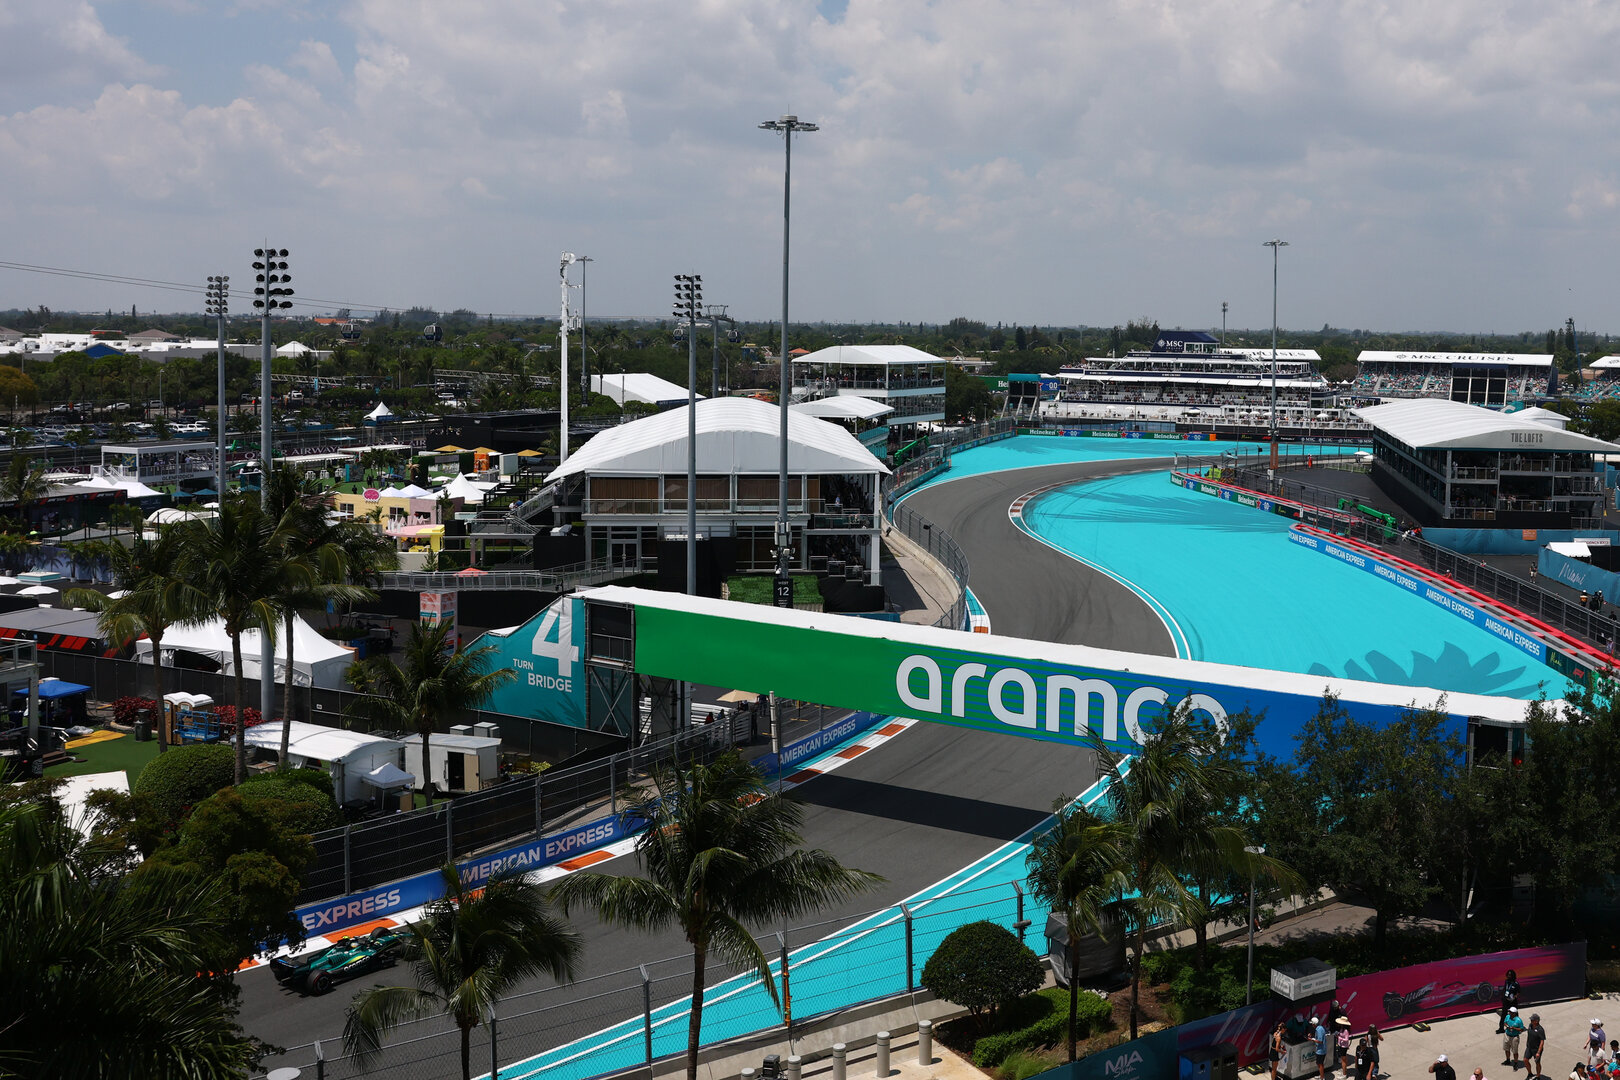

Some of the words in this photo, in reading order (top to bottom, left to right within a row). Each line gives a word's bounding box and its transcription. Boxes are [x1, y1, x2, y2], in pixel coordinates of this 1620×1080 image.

[1511, 433, 1522, 442] THE
[1524, 433, 1543, 443] LOFTS
[1201, 485, 1217, 495] Heineken
[1238, 495, 1256, 507] Heineken
[1299, 536, 1317, 548] EXPRESS
[1325, 545, 1345, 559] AMERICAN
[1346, 553, 1365, 567] EXPRESS
[1374, 564, 1396, 581] AMERICAN
[1397, 575, 1417, 591] EXPRESS
[778, 587, 789, 596] 12
[1426, 588, 1451, 609] AMERICAN
[1452, 601, 1475, 620] EXPRESS
[532, 597, 579, 677] 4
[1485, 618, 1514, 642] AMERICAN
[1515, 633, 1540, 656] EXPRESS
[513, 658, 534, 670] TURN
[528, 672, 572, 693] BRIDGE
[896, 654, 1230, 756] aramco
[780, 736, 821, 765] AMERICAN
[823, 719, 856, 746] EXPRESS
[546, 822, 613, 858] EXPRESS
[302, 888, 401, 930] EXPRESS
[344, 956, 370, 972] aramco
[1105, 1050, 1143, 1076] MIA
